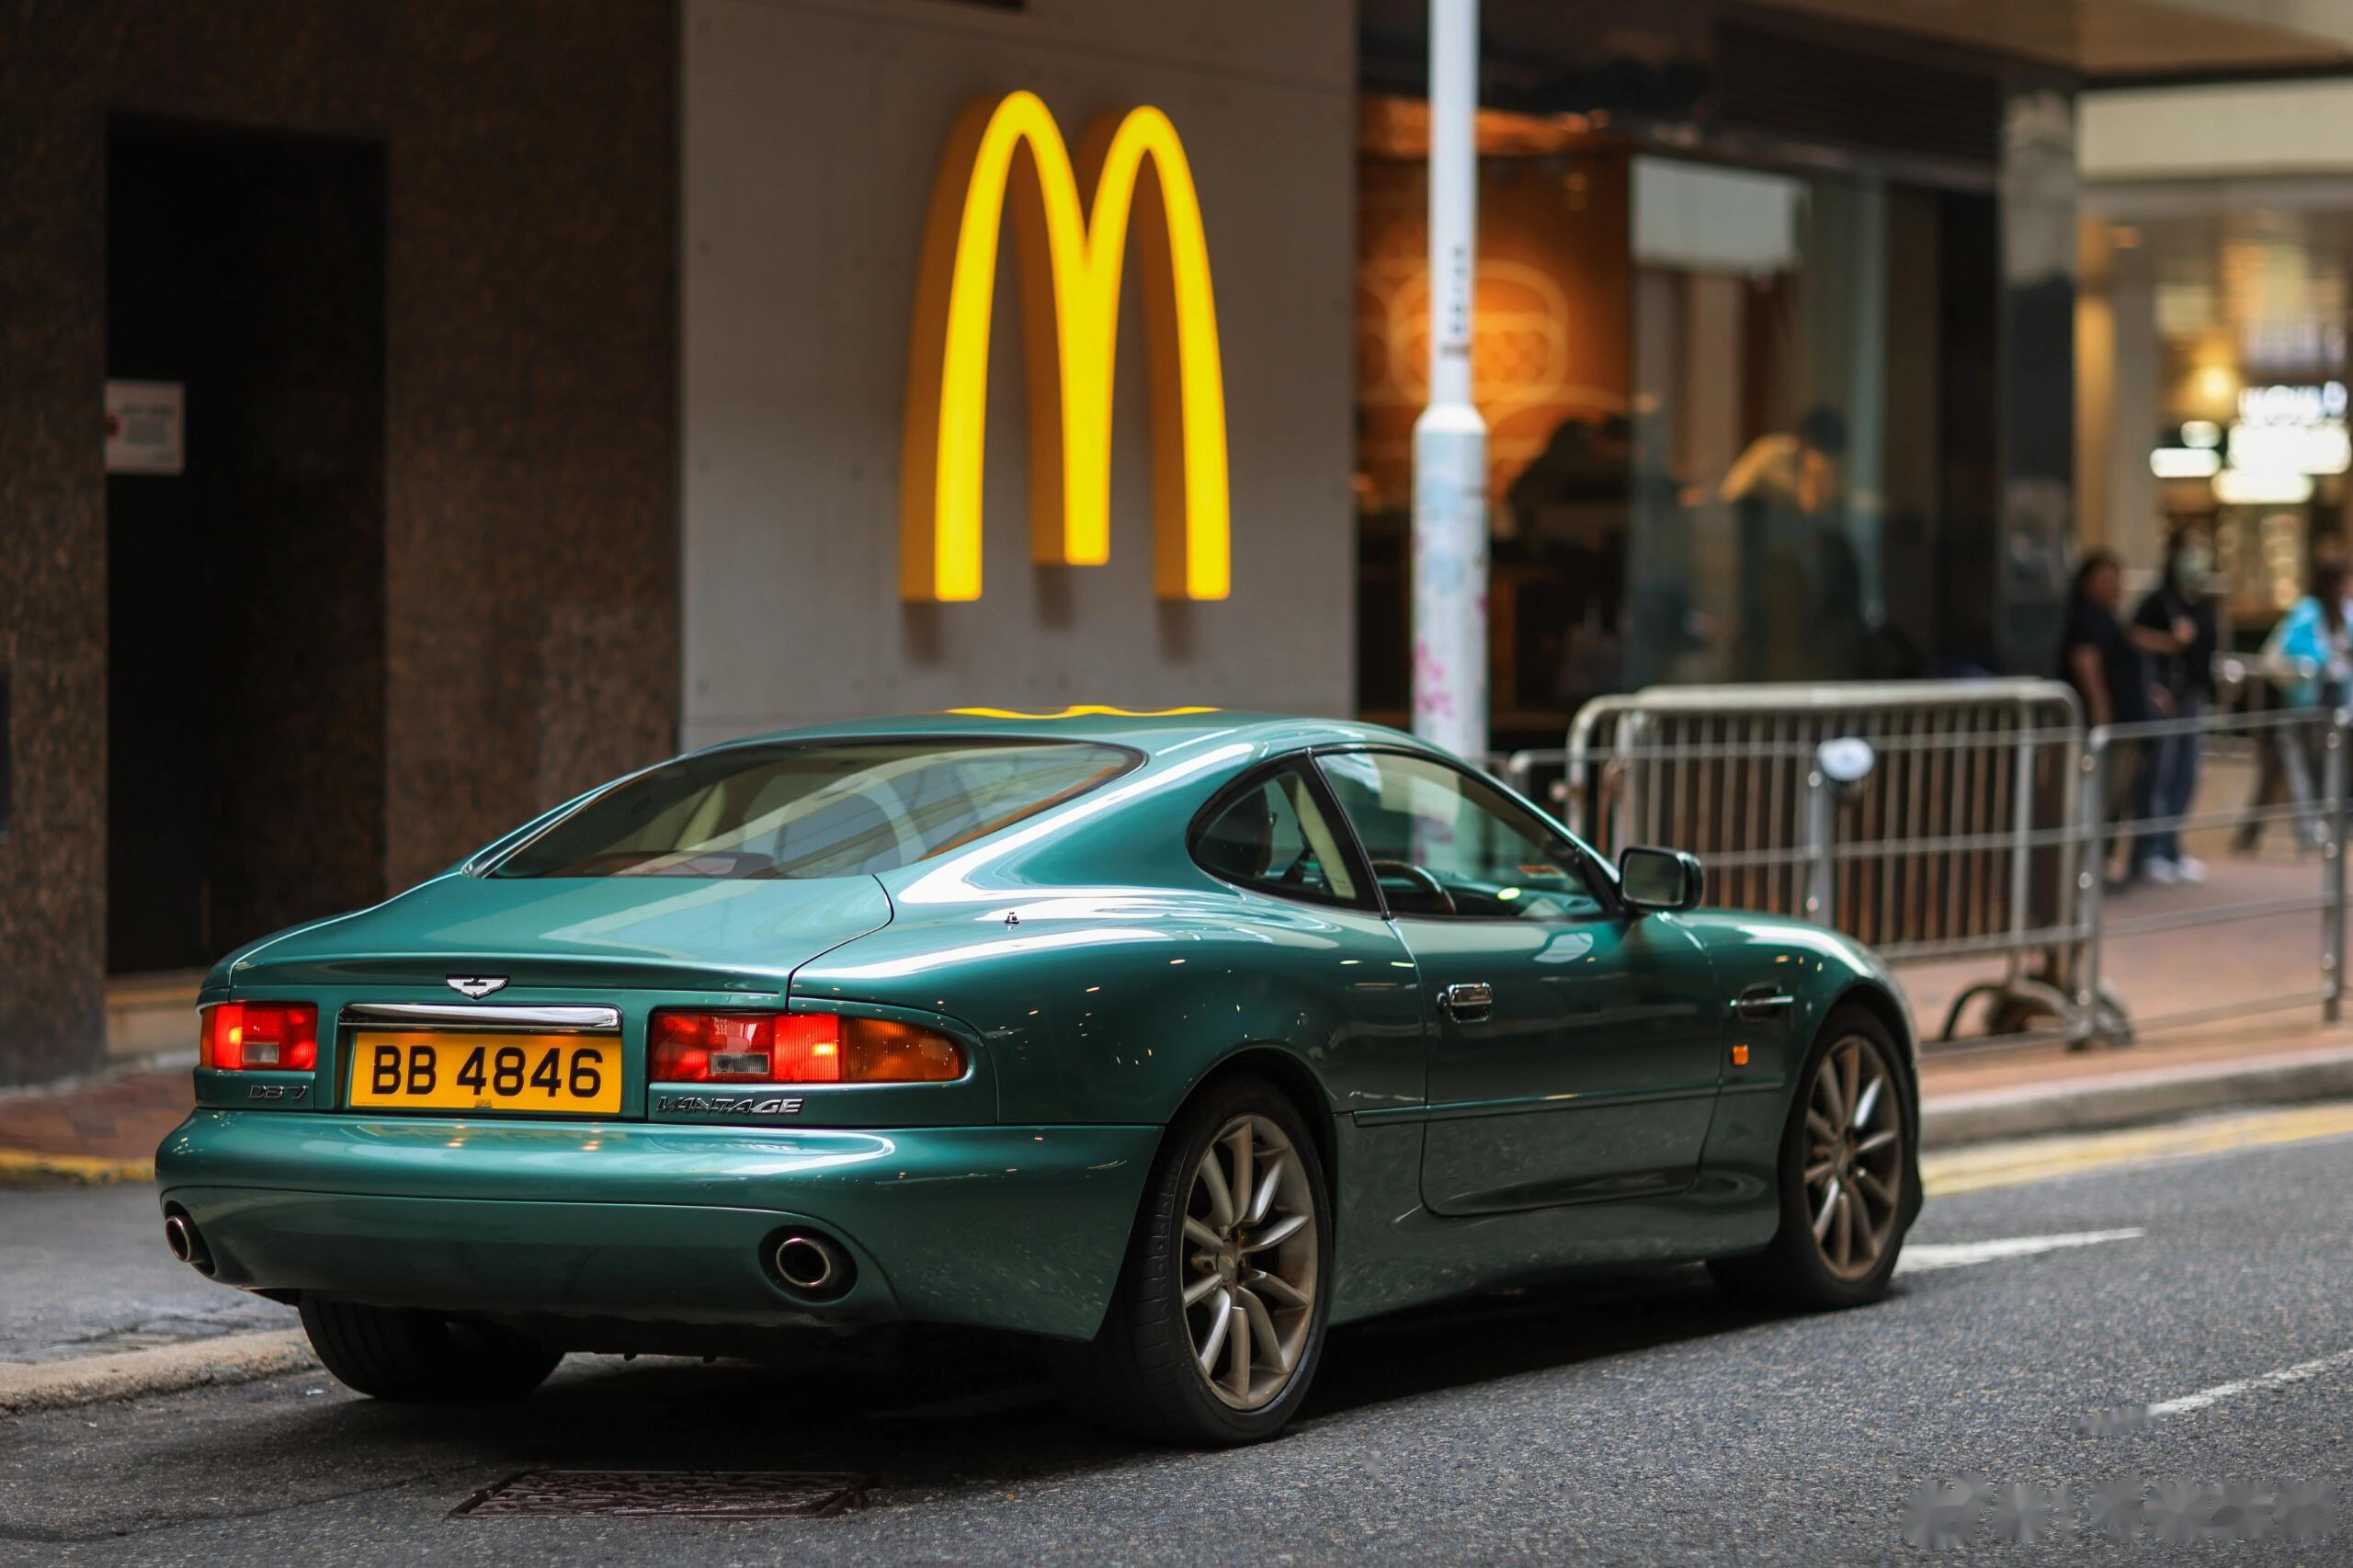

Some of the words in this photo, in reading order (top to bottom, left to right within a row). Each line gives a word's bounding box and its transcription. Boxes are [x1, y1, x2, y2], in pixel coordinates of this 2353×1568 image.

[371, 1044, 437, 1096] BB
[456, 1046, 604, 1098] 4846
[656, 1096, 804, 1115] VANTAGE
